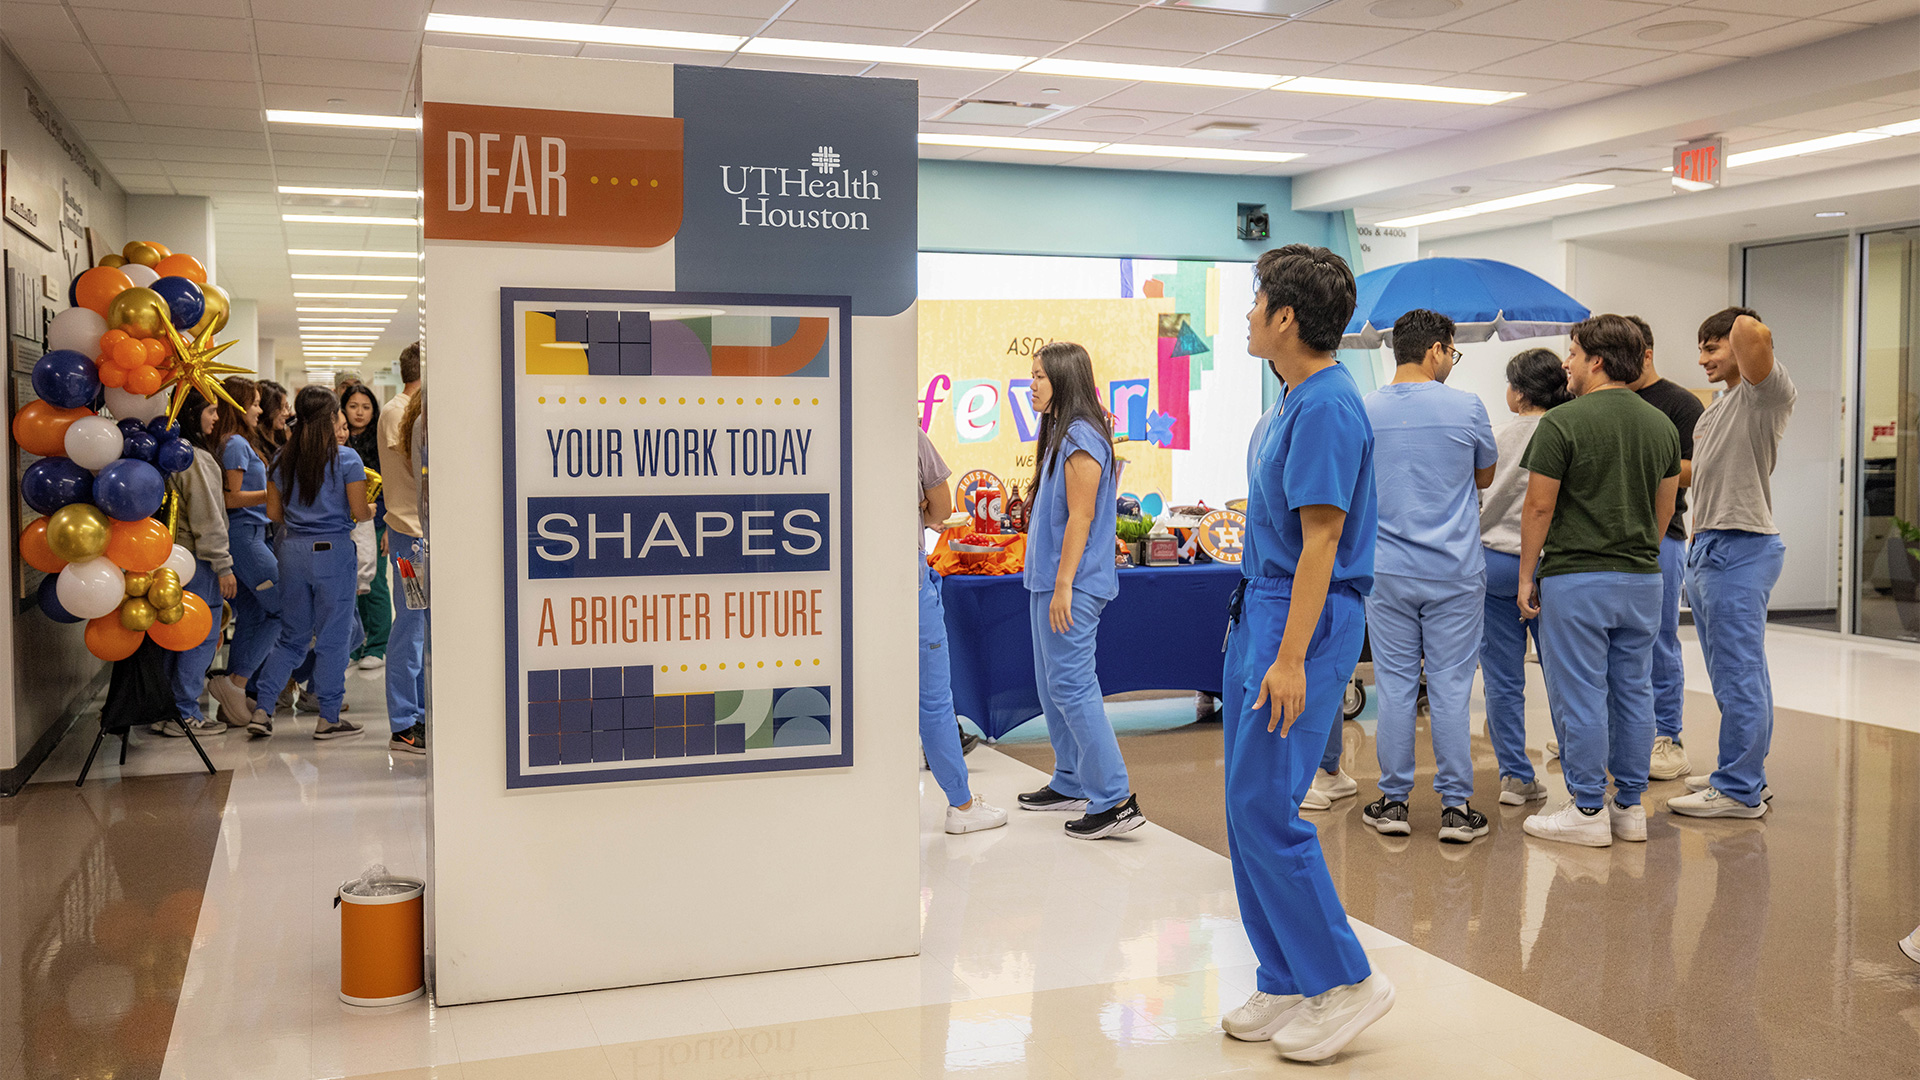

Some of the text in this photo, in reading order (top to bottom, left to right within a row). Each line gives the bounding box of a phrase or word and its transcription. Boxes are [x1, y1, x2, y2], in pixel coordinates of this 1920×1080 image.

[447, 130, 567, 217] DEAR
[1681, 145, 1715, 182] EXIT
[737, 197, 870, 231] Houston
[1383, 229, 1406, 237] 4400s
[1006, 336, 1054, 356] ASD
[546, 427, 812, 478] YOUR WORK TODAY
[535, 508, 823, 562] SHAPES
[1215, 526, 1244, 548] H
[537, 588, 823, 647] A BRIGHTER FUTURE
[1116, 807, 1134, 820] HOKA
